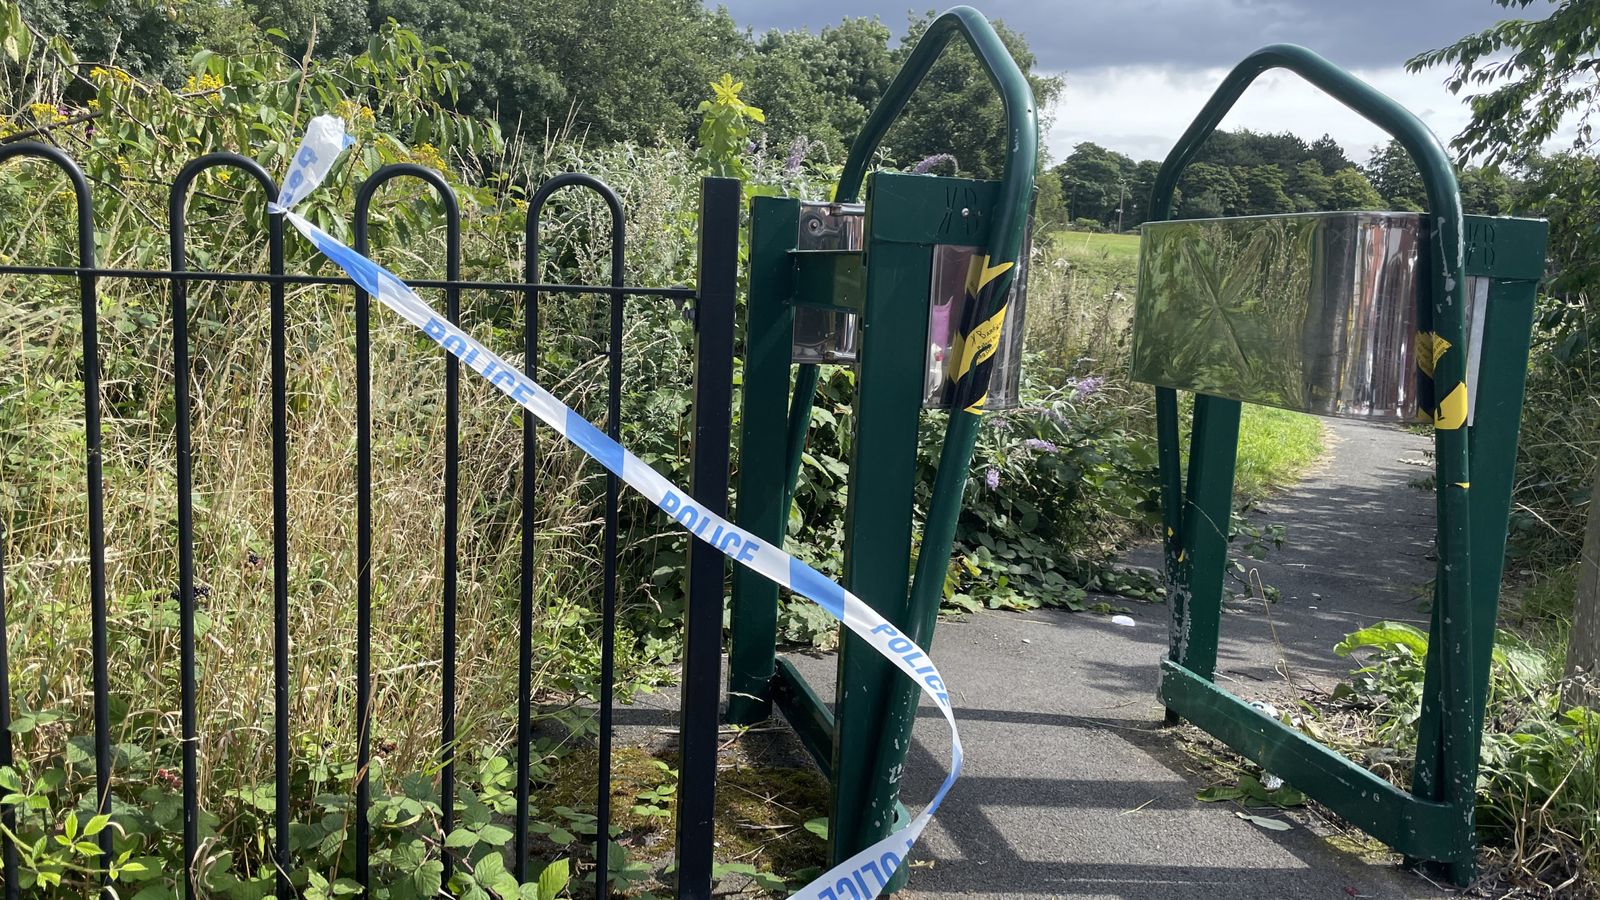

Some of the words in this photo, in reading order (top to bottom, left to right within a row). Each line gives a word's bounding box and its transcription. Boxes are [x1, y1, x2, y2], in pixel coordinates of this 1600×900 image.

[423, 317, 535, 405] POLICE
[659, 490, 759, 562] POLICE
[870, 623, 950, 707] POLICE
